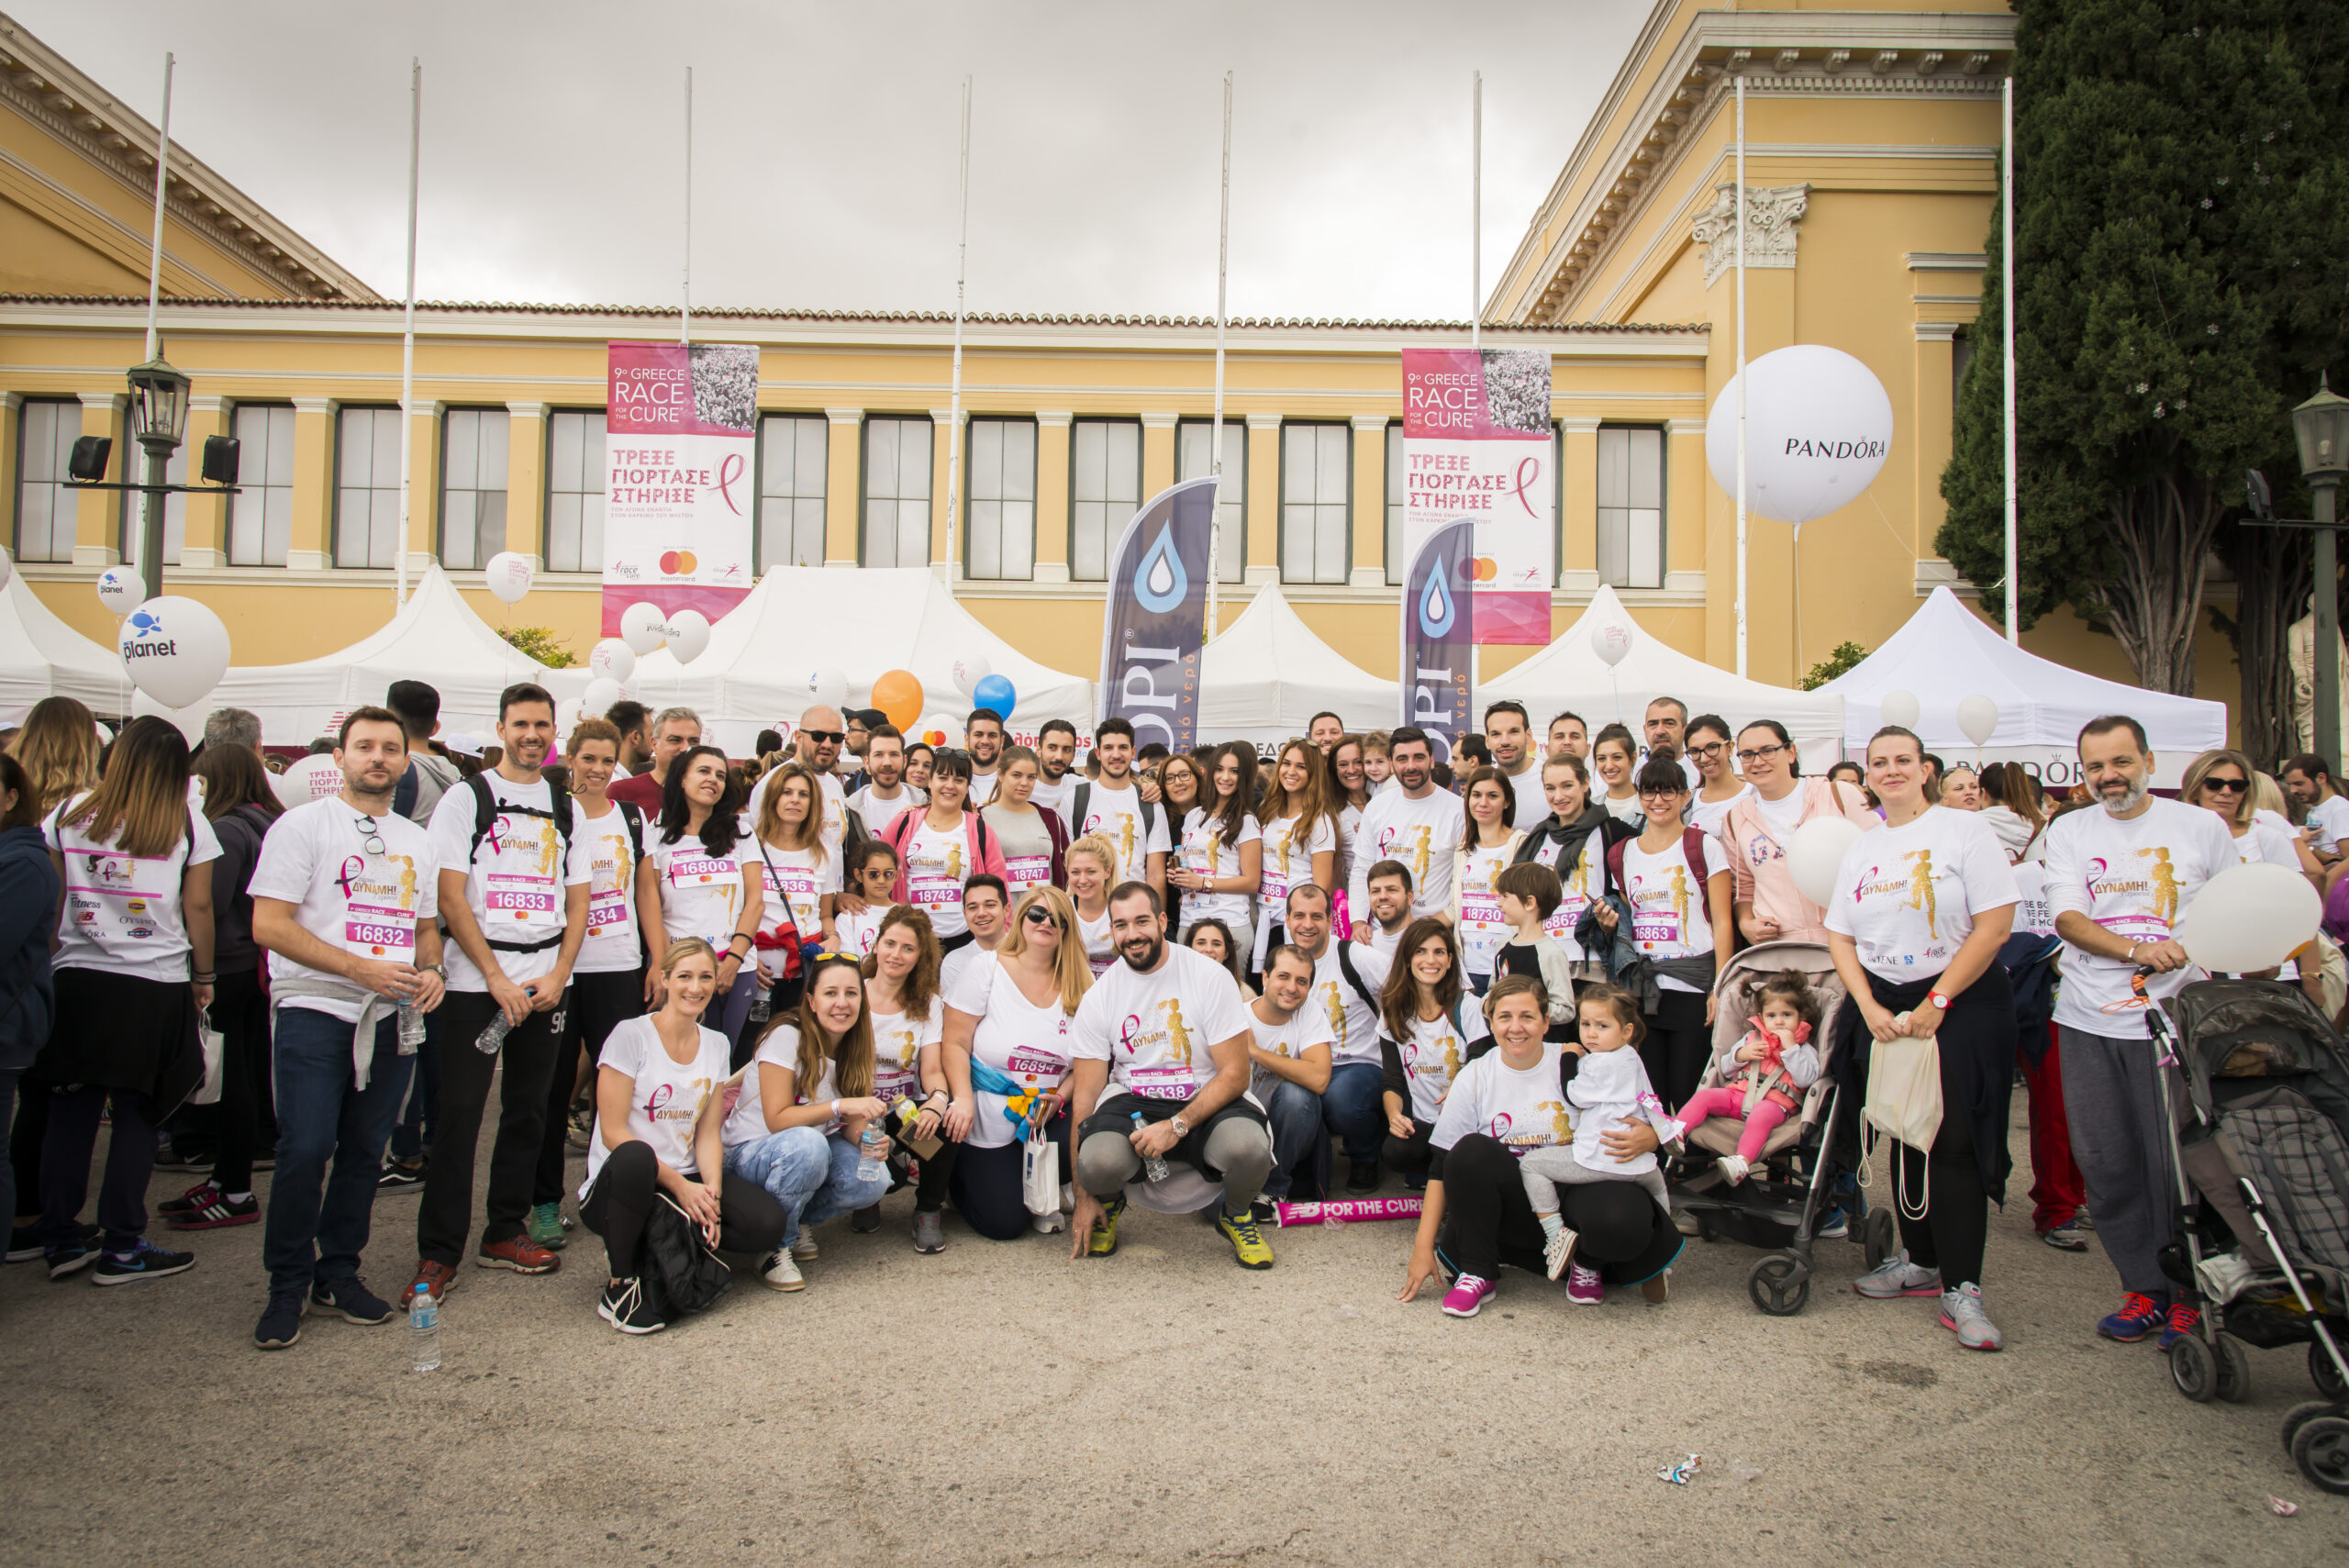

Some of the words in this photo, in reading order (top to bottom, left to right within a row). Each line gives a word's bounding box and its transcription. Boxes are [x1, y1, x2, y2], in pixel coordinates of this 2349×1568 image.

[630, 368, 685, 381] GREECE
[1424, 373, 1478, 386] GREECE
[615, 382, 685, 405] RACE
[1409, 387, 1478, 409] RACE
[1785, 437, 1886, 459] PANDORA
[613, 450, 675, 465] ΤΡΕΞΕ
[1408, 453, 1470, 472] ΤΡΕΞΕ
[612, 469, 710, 485] ΓΙΟΡΤΑΣΕ
[1408, 473, 1507, 490] ΓΙΟΡΤΑΣΕ
[611, 488, 696, 504] ΣΤΗΡΙΞΕ
[1408, 492, 1492, 510] ΣΤΗΡΙΞΕ
[123, 639, 176, 663] planet
[309, 770, 339, 778] ΤΡΕΞΕ
[309, 778, 344, 786] ΓΙΟΡΤΑ
[681, 862, 728, 875] 16800
[909, 858, 944, 868] ΔΥΝΑΜΗ!
[1013, 868, 1043, 881] 18747
[352, 882, 397, 896] ΔΥΝΑΜΗ!
[764, 879, 807, 892] 16836
[1262, 884, 1282, 896] 868
[1863, 879, 1908, 895] ΔΥΝΑΜΗ!
[2095, 881, 2148, 894] ΔΥΝΑΜΗ!
[495, 893, 546, 910] 16833
[918, 890, 953, 902] 18742
[587, 907, 618, 926] 834
[1466, 907, 1501, 921] 18730
[354, 925, 405, 945] 16832
[1635, 927, 1669, 940] 16863
[1014, 1059, 1055, 1073] 16894
[656, 1109, 694, 1120] ΔΥΝΑΜΗ!
[1323, 1202, 1353, 1217] FOR
[1355, 1199, 1383, 1215] THE
